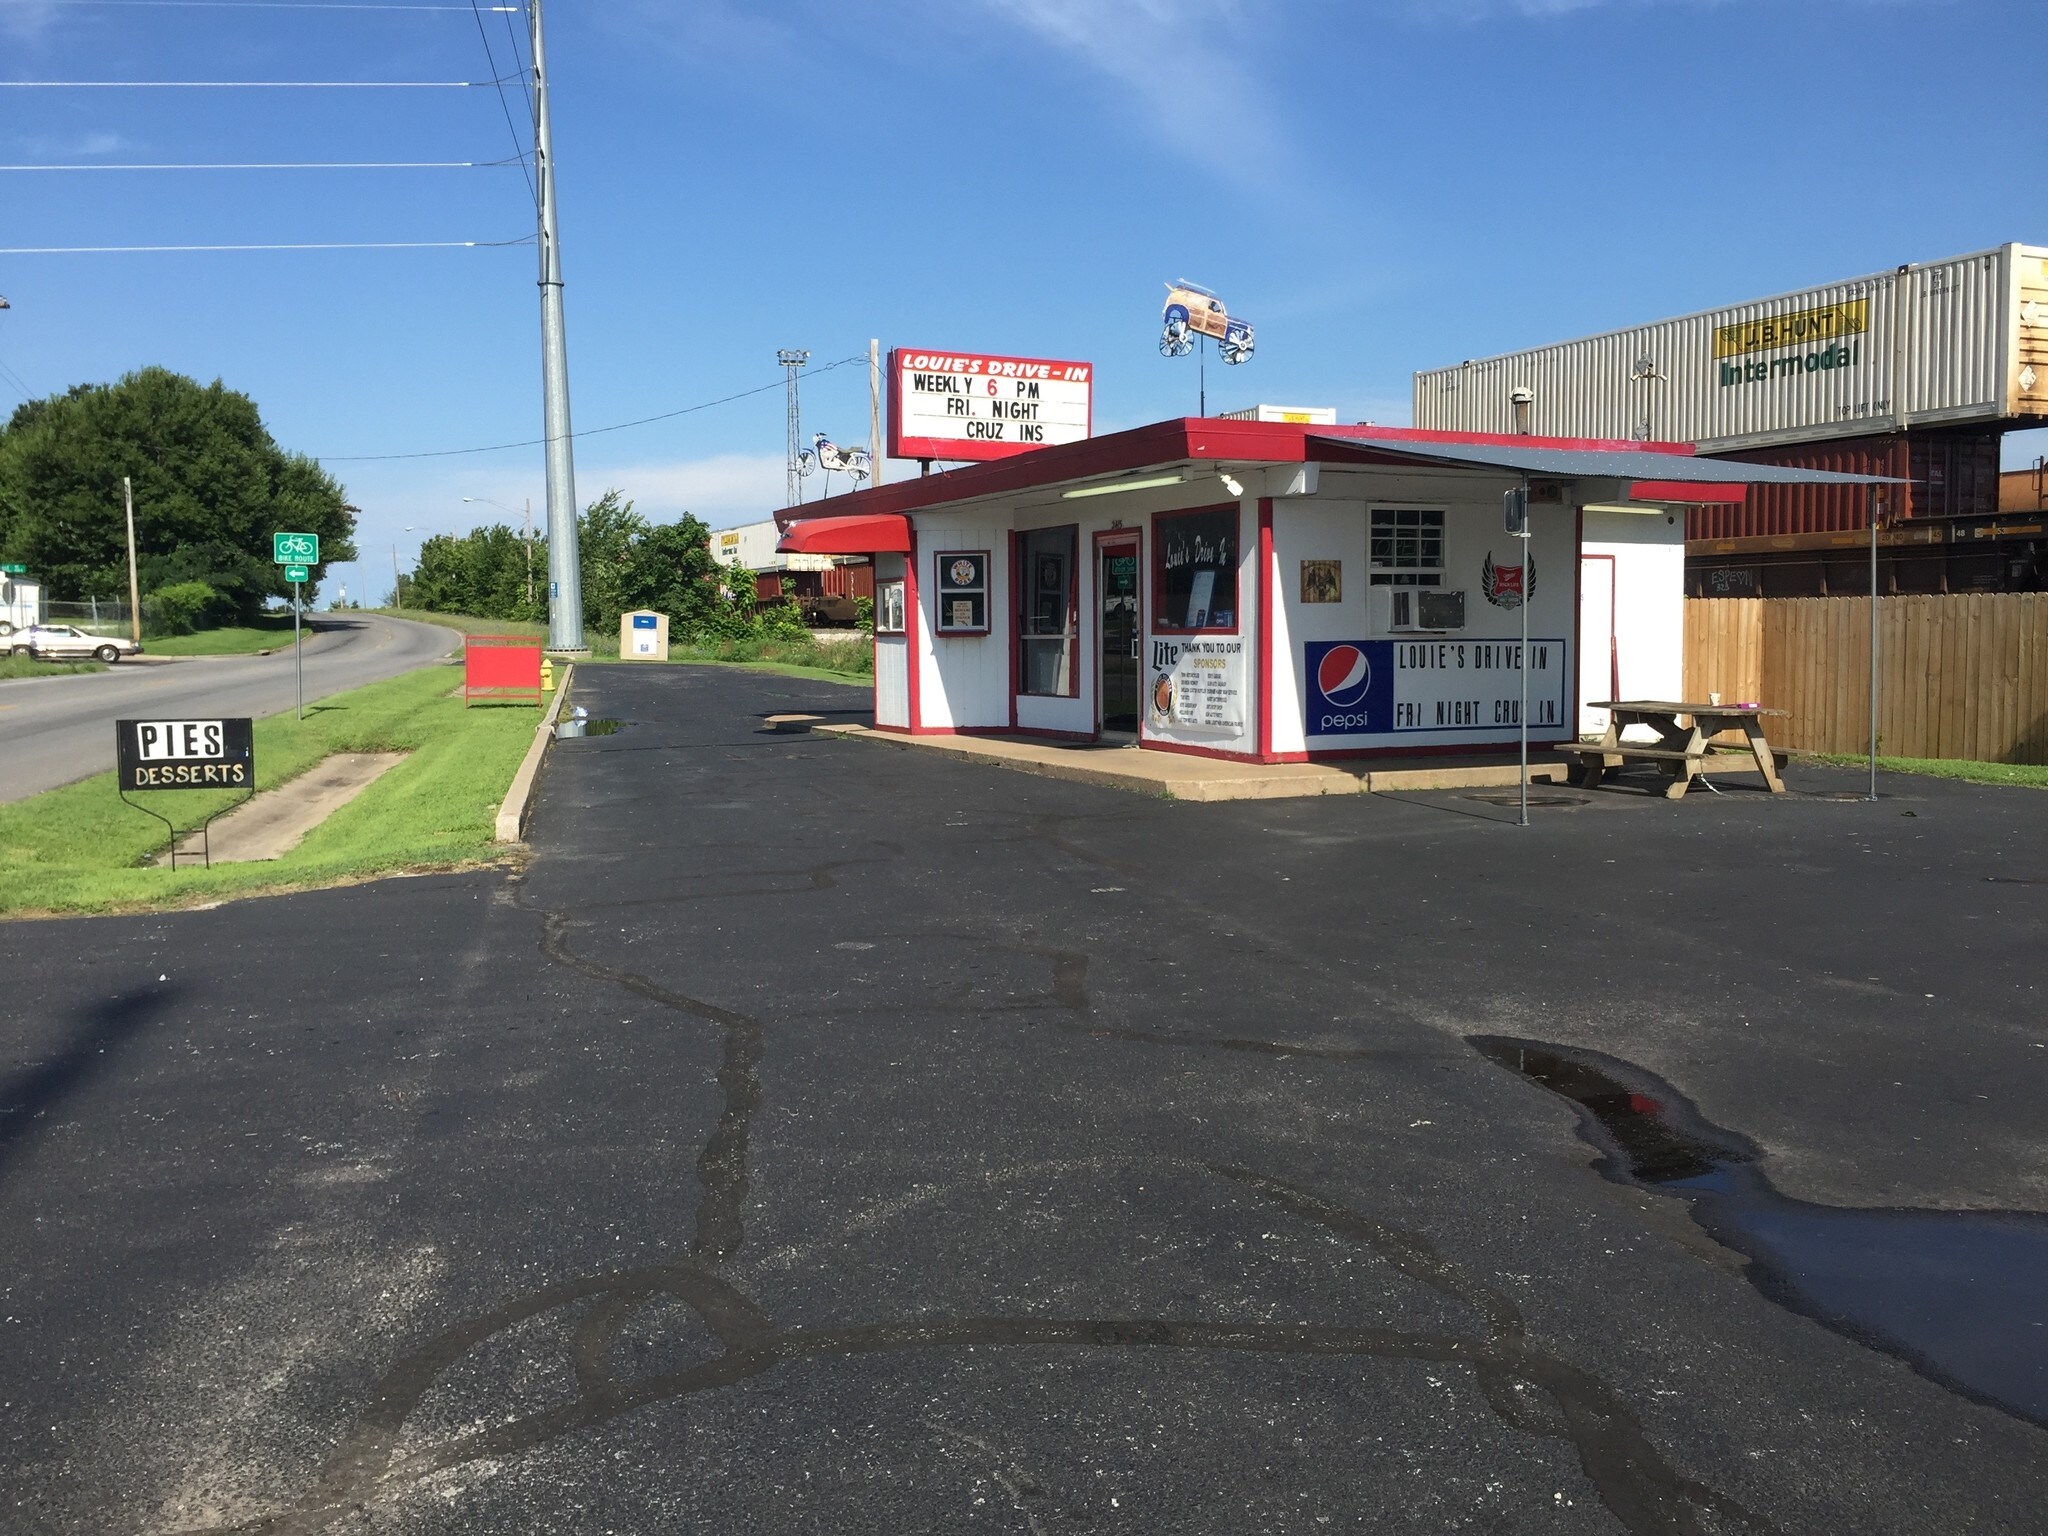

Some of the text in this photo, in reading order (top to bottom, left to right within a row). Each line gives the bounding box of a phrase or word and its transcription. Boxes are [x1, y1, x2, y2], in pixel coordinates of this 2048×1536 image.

[902, 353, 983, 374] LOUIE'S
[1721, 339, 1859, 387] Intermodal
[913, 373, 1040, 399] WEEKLY 6 PM
[947, 398, 1039, 420] FRI. NIGHT
[966, 421, 1043, 441] CRUZ INS
[1956, 529, 1966, 537] 48
[294, 555, 314, 563] ROUTE
[1152, 640, 1178, 672] Lite
[1181, 642, 1241, 654] THANK YOU TO OUR
[1399, 644, 1547, 670] LOUIE'S DRIVE IN
[1193, 658, 1227, 669] SPONSORS
[1321, 710, 1368, 731] pepsi
[1397, 702, 1421, 727] FRI
[1437, 700, 1480, 725] NIGHT
[1539, 700, 1555, 724] IN
[141, 723, 221, 757] PIES
[136, 763, 245, 786] DESSERTS
